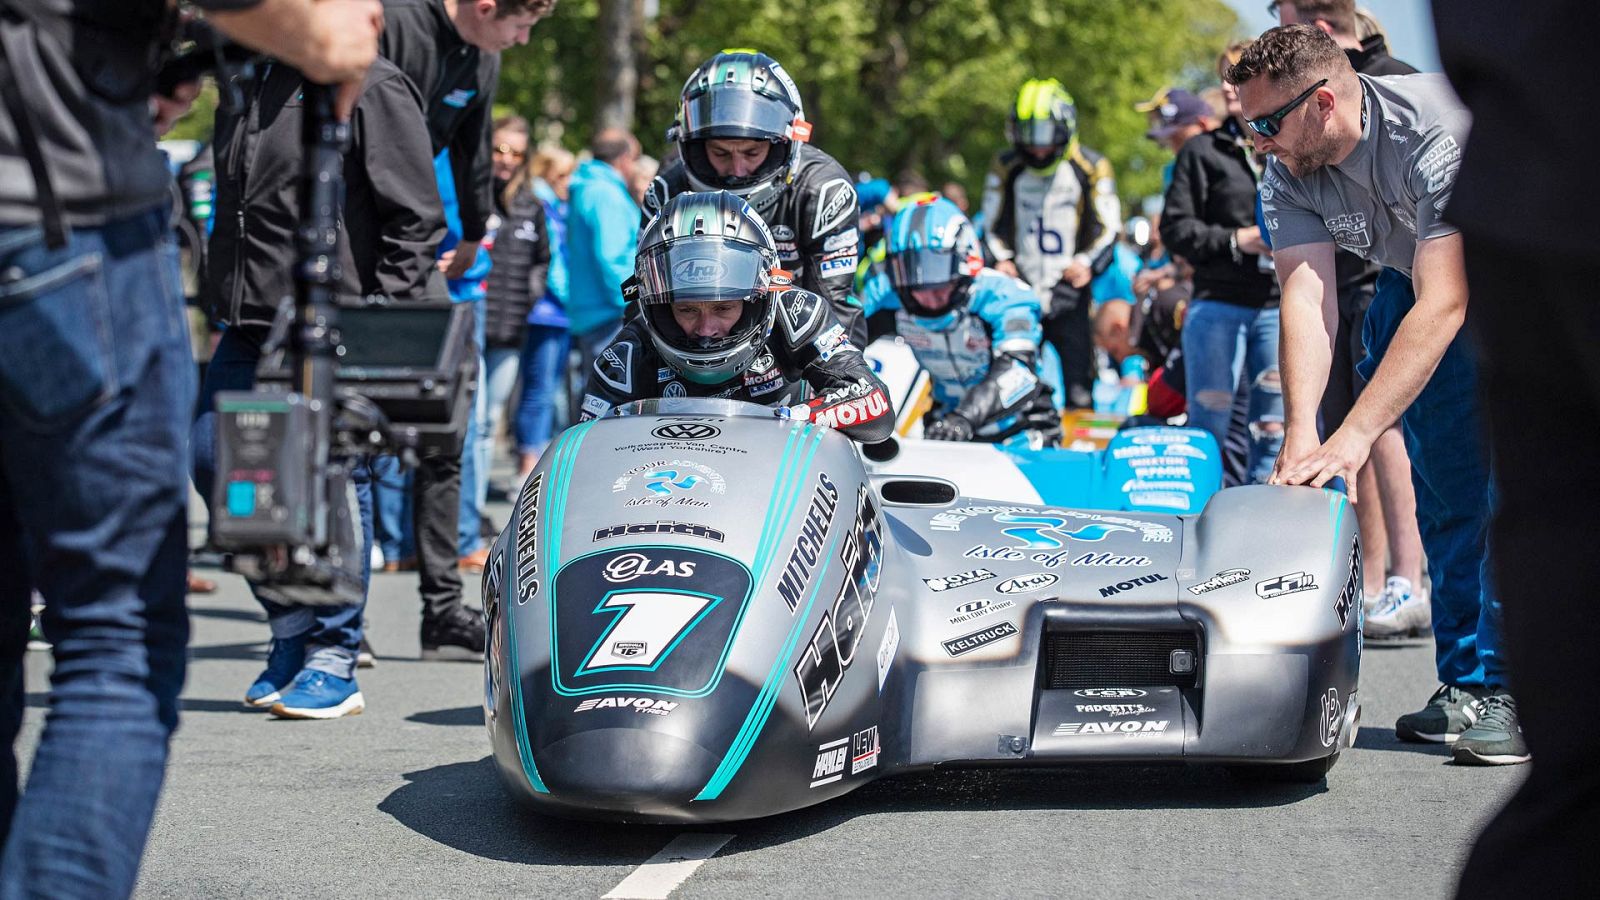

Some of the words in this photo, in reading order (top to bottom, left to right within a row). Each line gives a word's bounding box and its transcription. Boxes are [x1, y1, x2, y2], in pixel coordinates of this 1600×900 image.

[789, 290, 808, 326] RST
[815, 391, 889, 428] MOTUL
[614, 441, 680, 452] Volkswagen
[710, 443, 748, 454] Centre
[624, 496, 651, 508] Isle
[656, 496, 673, 507] of
[517, 471, 545, 606] MITCHELLS
[593, 519, 725, 543] Haith
[776, 471, 840, 616] MITCHELLS
[964, 545, 1025, 560] Isle
[1030, 551, 1066, 568] of
[1071, 552, 1151, 567] Man
[1003, 573, 1052, 593] Arai
[1099, 574, 1168, 598] MOTUL
[950, 608, 989, 625] MALLORY
[990, 600, 1014, 613] PARK
[577, 589, 720, 675] 1
[947, 623, 1015, 654] KELTRUCK
[596, 697, 680, 711] AVON
[635, 707, 670, 716] TYRES
[1080, 720, 1171, 733] AVON
[853, 725, 878, 758] LEW
